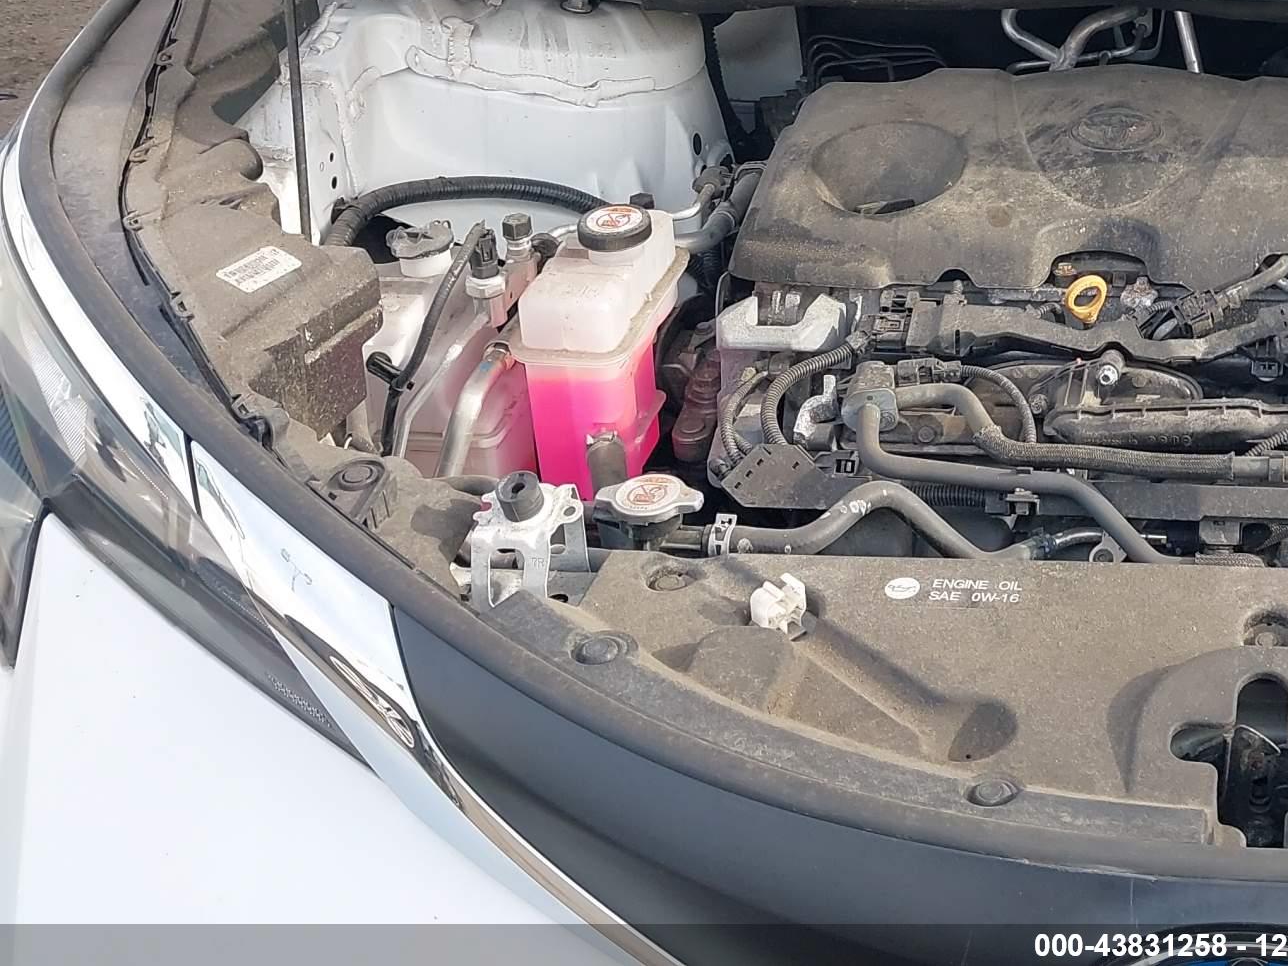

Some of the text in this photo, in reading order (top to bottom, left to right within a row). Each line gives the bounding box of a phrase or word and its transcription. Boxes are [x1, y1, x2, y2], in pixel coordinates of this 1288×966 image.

[932, 578, 1023, 591] ENGINE OIL
[928, 590, 1020, 603] SAE 0W-16
